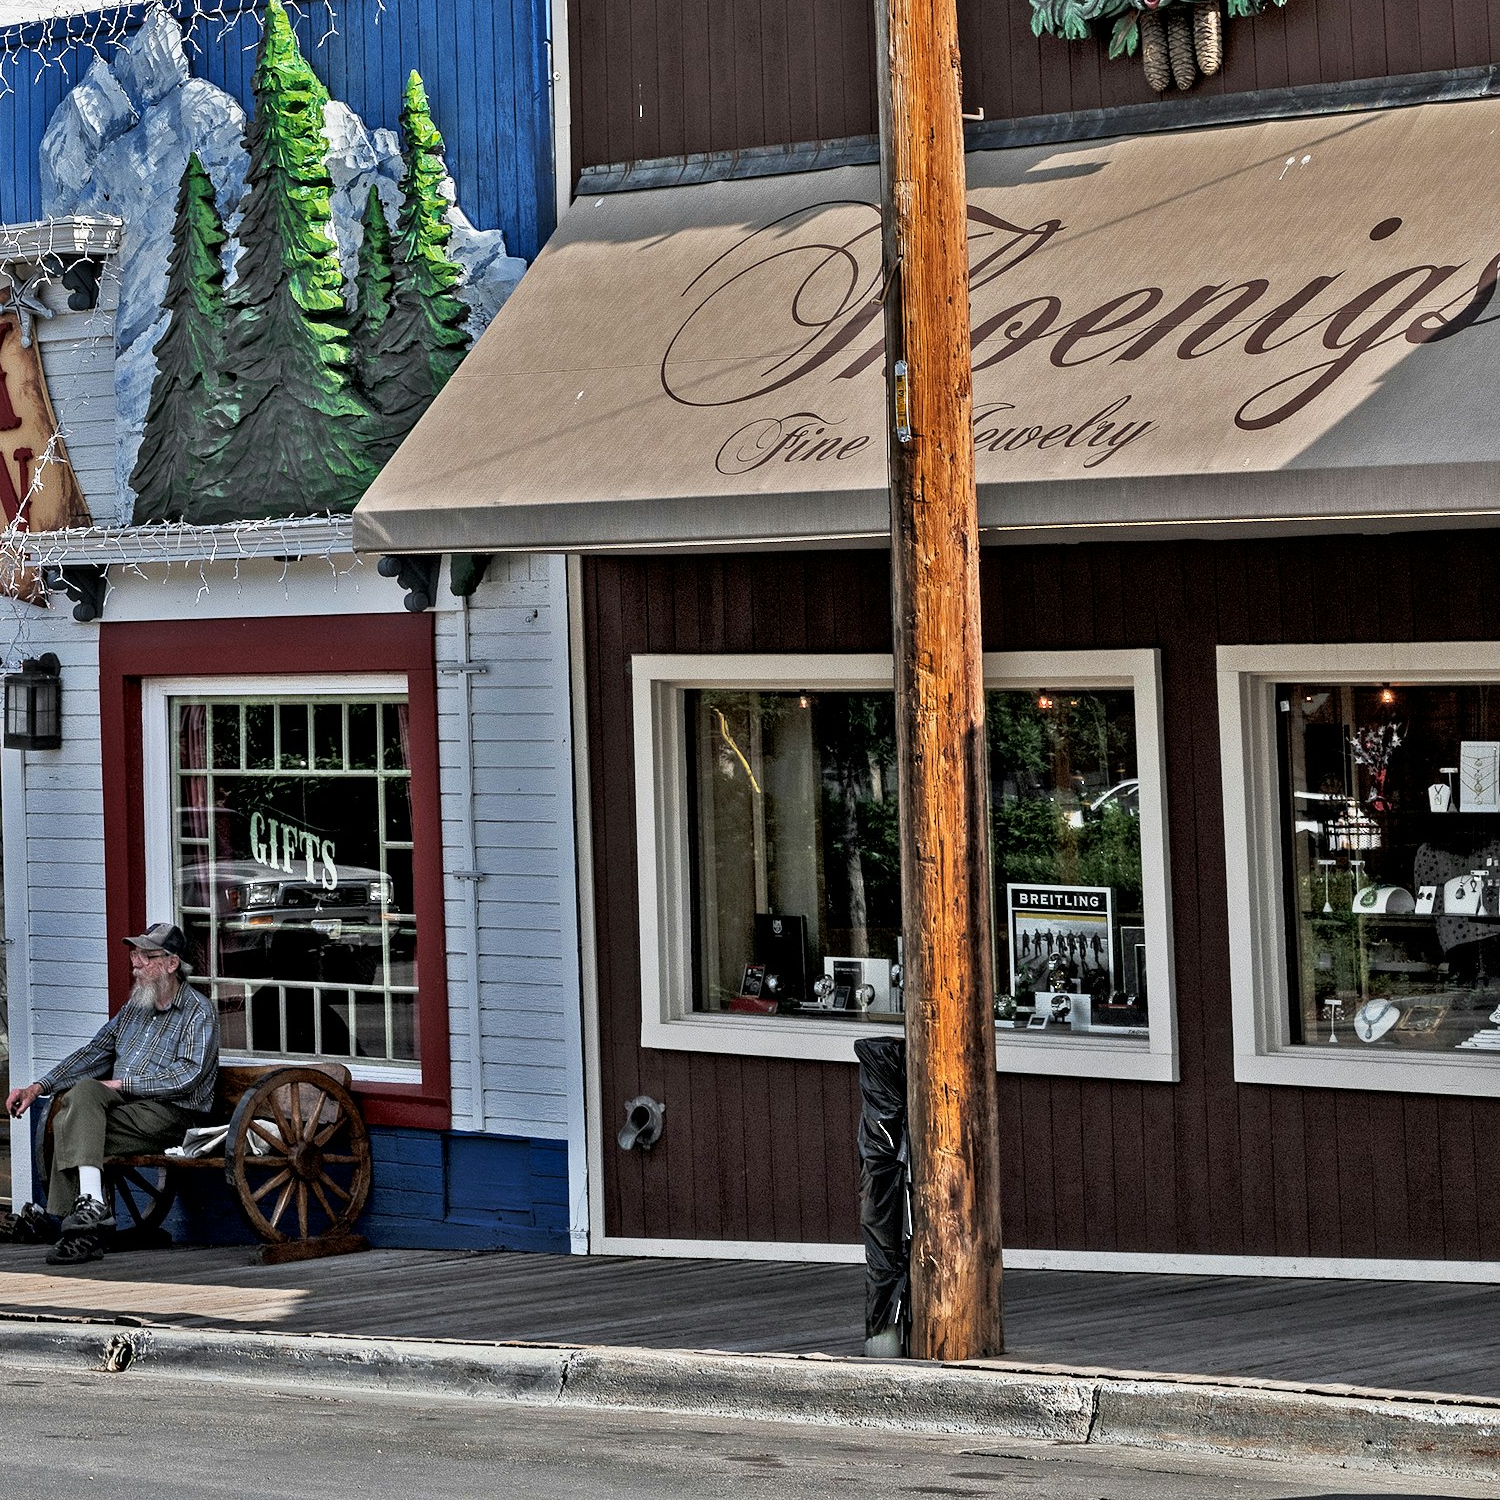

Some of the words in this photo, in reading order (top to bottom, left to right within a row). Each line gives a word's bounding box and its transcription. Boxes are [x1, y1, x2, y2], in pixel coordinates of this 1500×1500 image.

[715, 412, 876, 476] Fine
[249, 811, 338, 891] GIFTS
[1019, 893, 1100, 907] BREITLING
